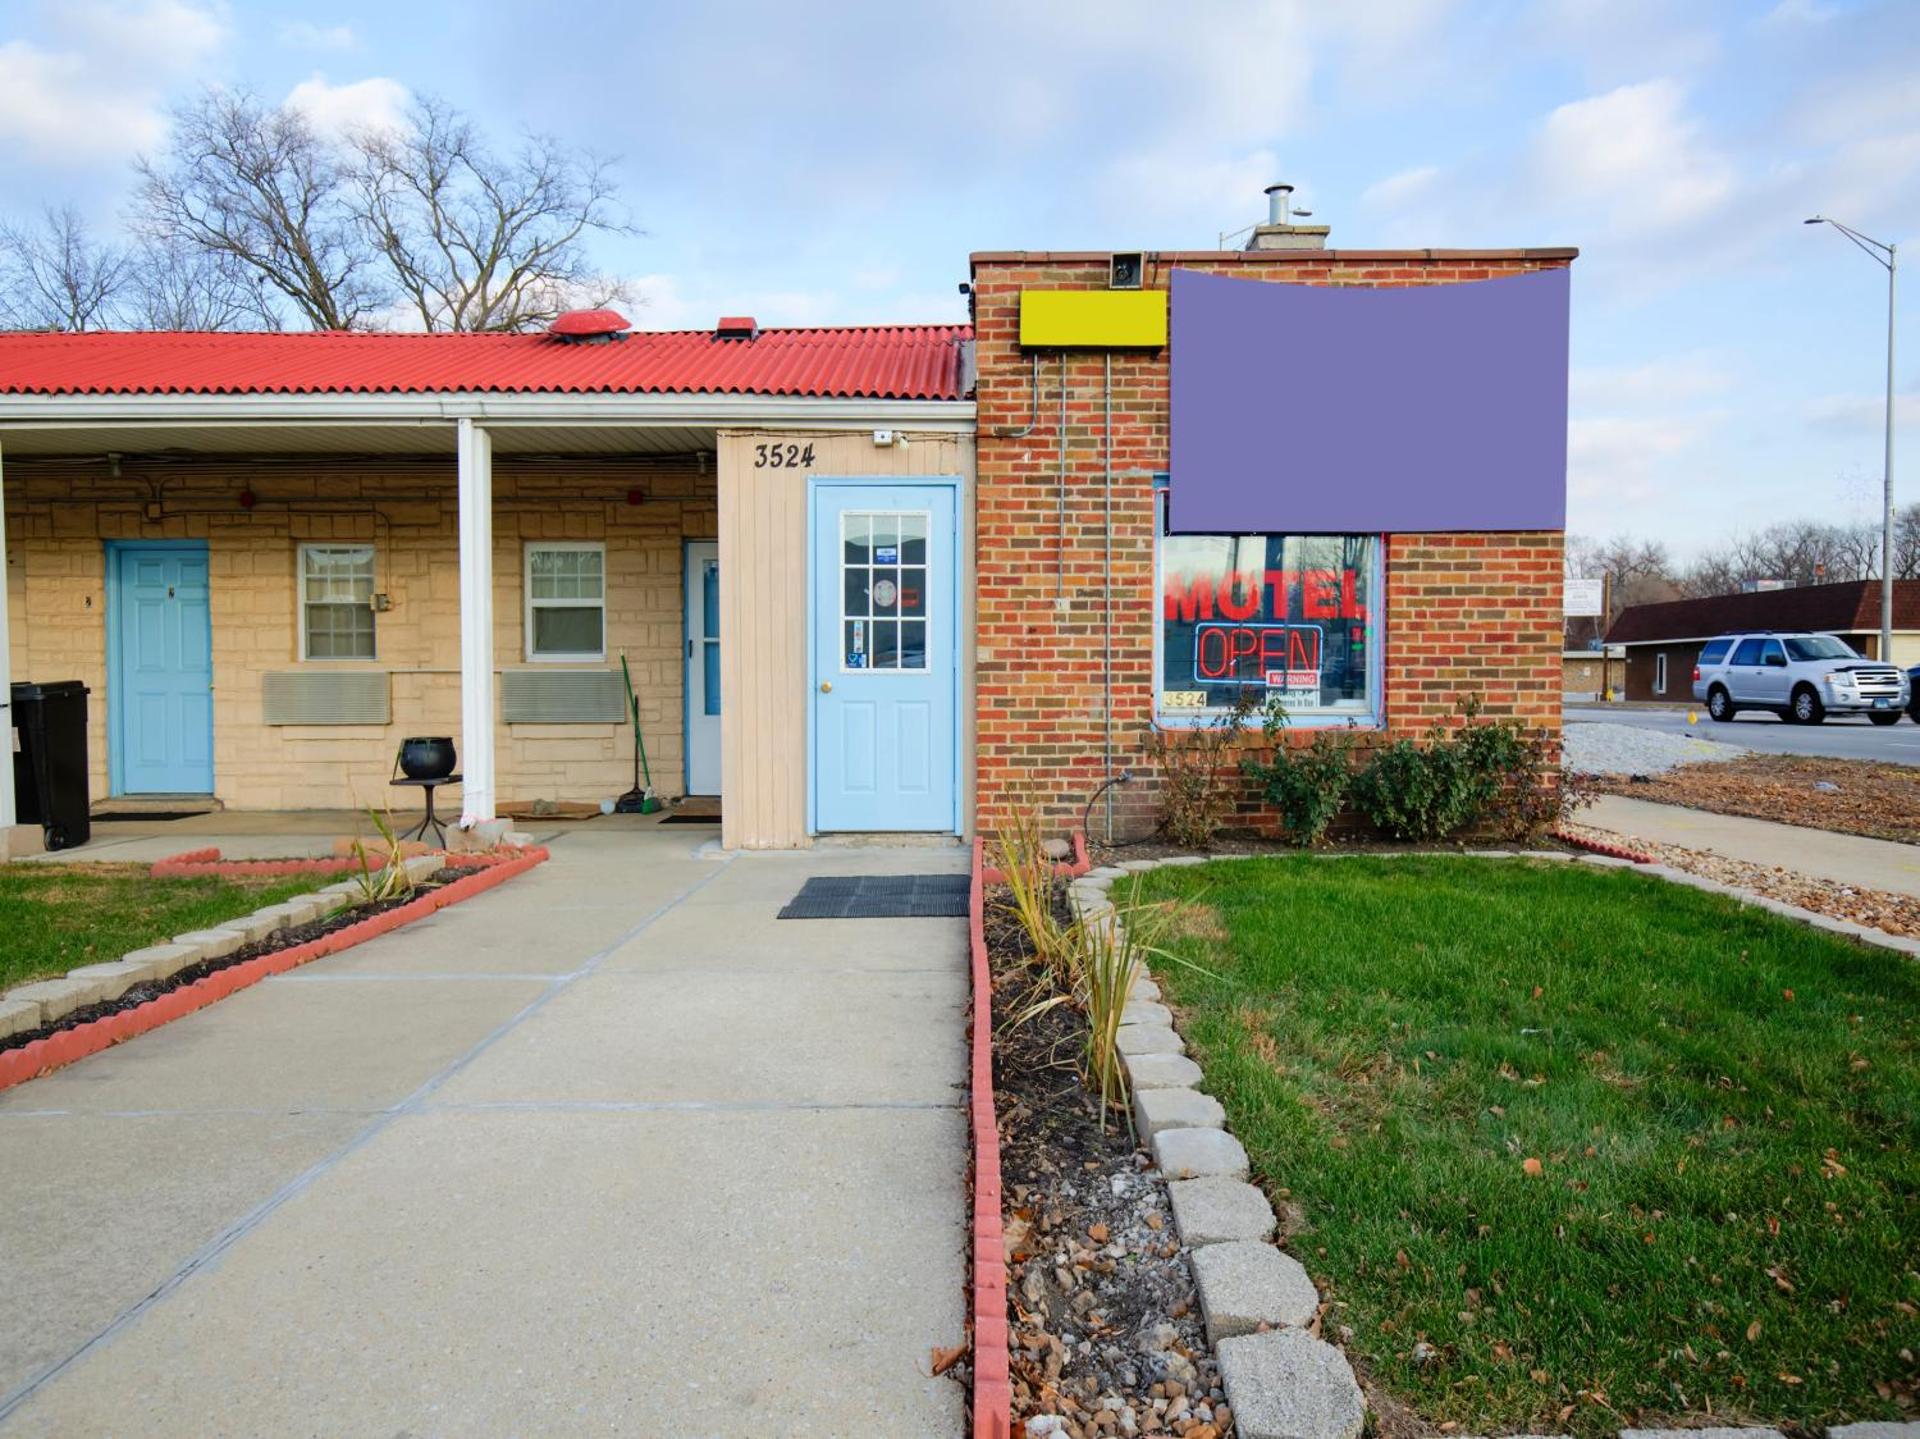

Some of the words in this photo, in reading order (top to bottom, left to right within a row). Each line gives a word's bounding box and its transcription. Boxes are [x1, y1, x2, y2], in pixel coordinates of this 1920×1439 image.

[754, 442, 815, 468] 3524
[1163, 569, 1366, 621] MOTEL
[1199, 627, 1319, 678] OPEN
[1165, 692, 1206, 706] 3524
